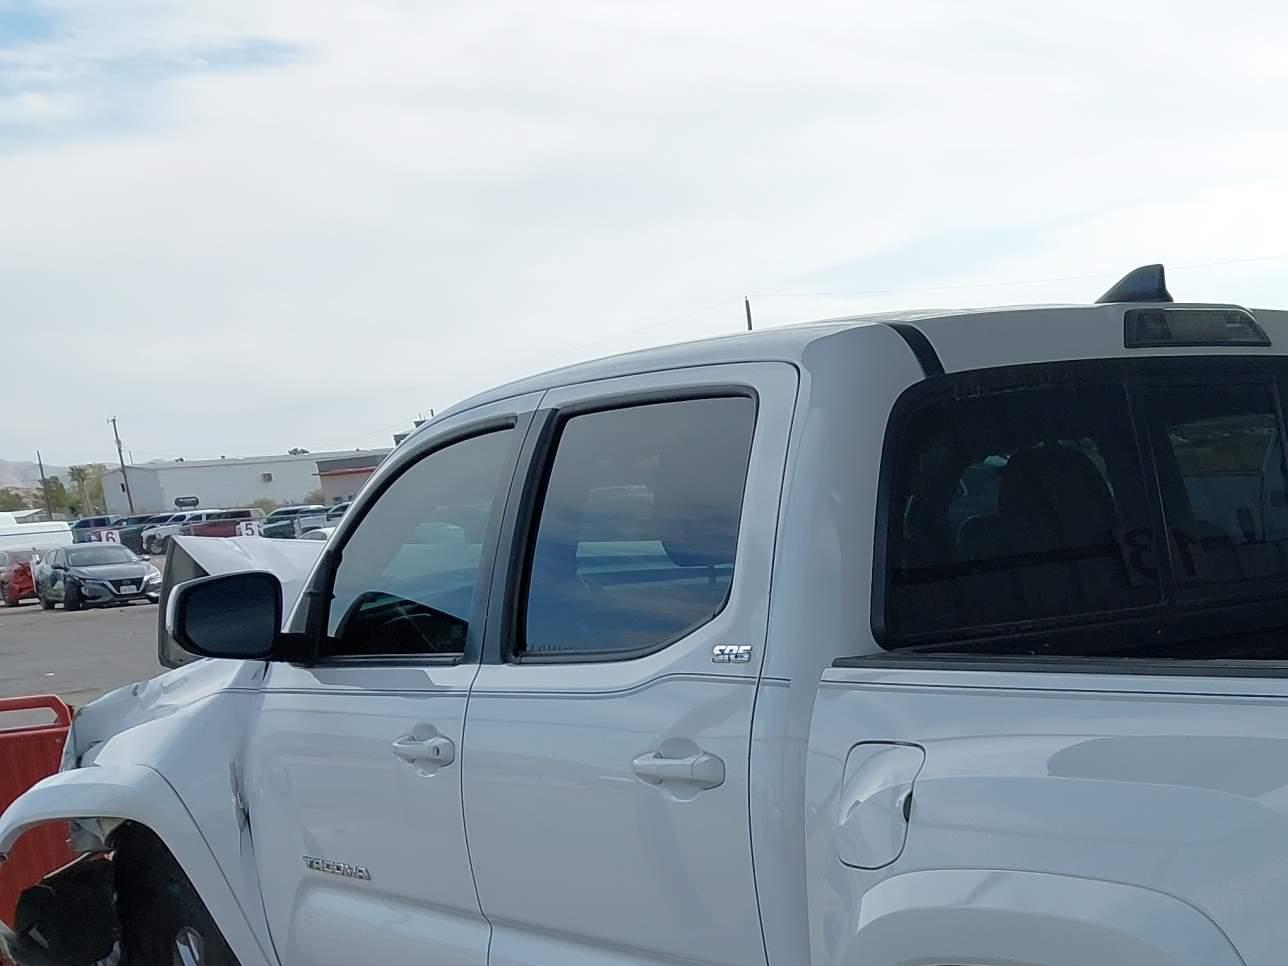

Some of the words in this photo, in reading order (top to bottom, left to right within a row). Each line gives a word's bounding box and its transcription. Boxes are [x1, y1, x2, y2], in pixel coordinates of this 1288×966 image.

[244, 522, 255, 536] 5
[105, 531, 116, 544] 6
[711, 645, 752, 664] SR5
[302, 855, 371, 881] TACOMA
